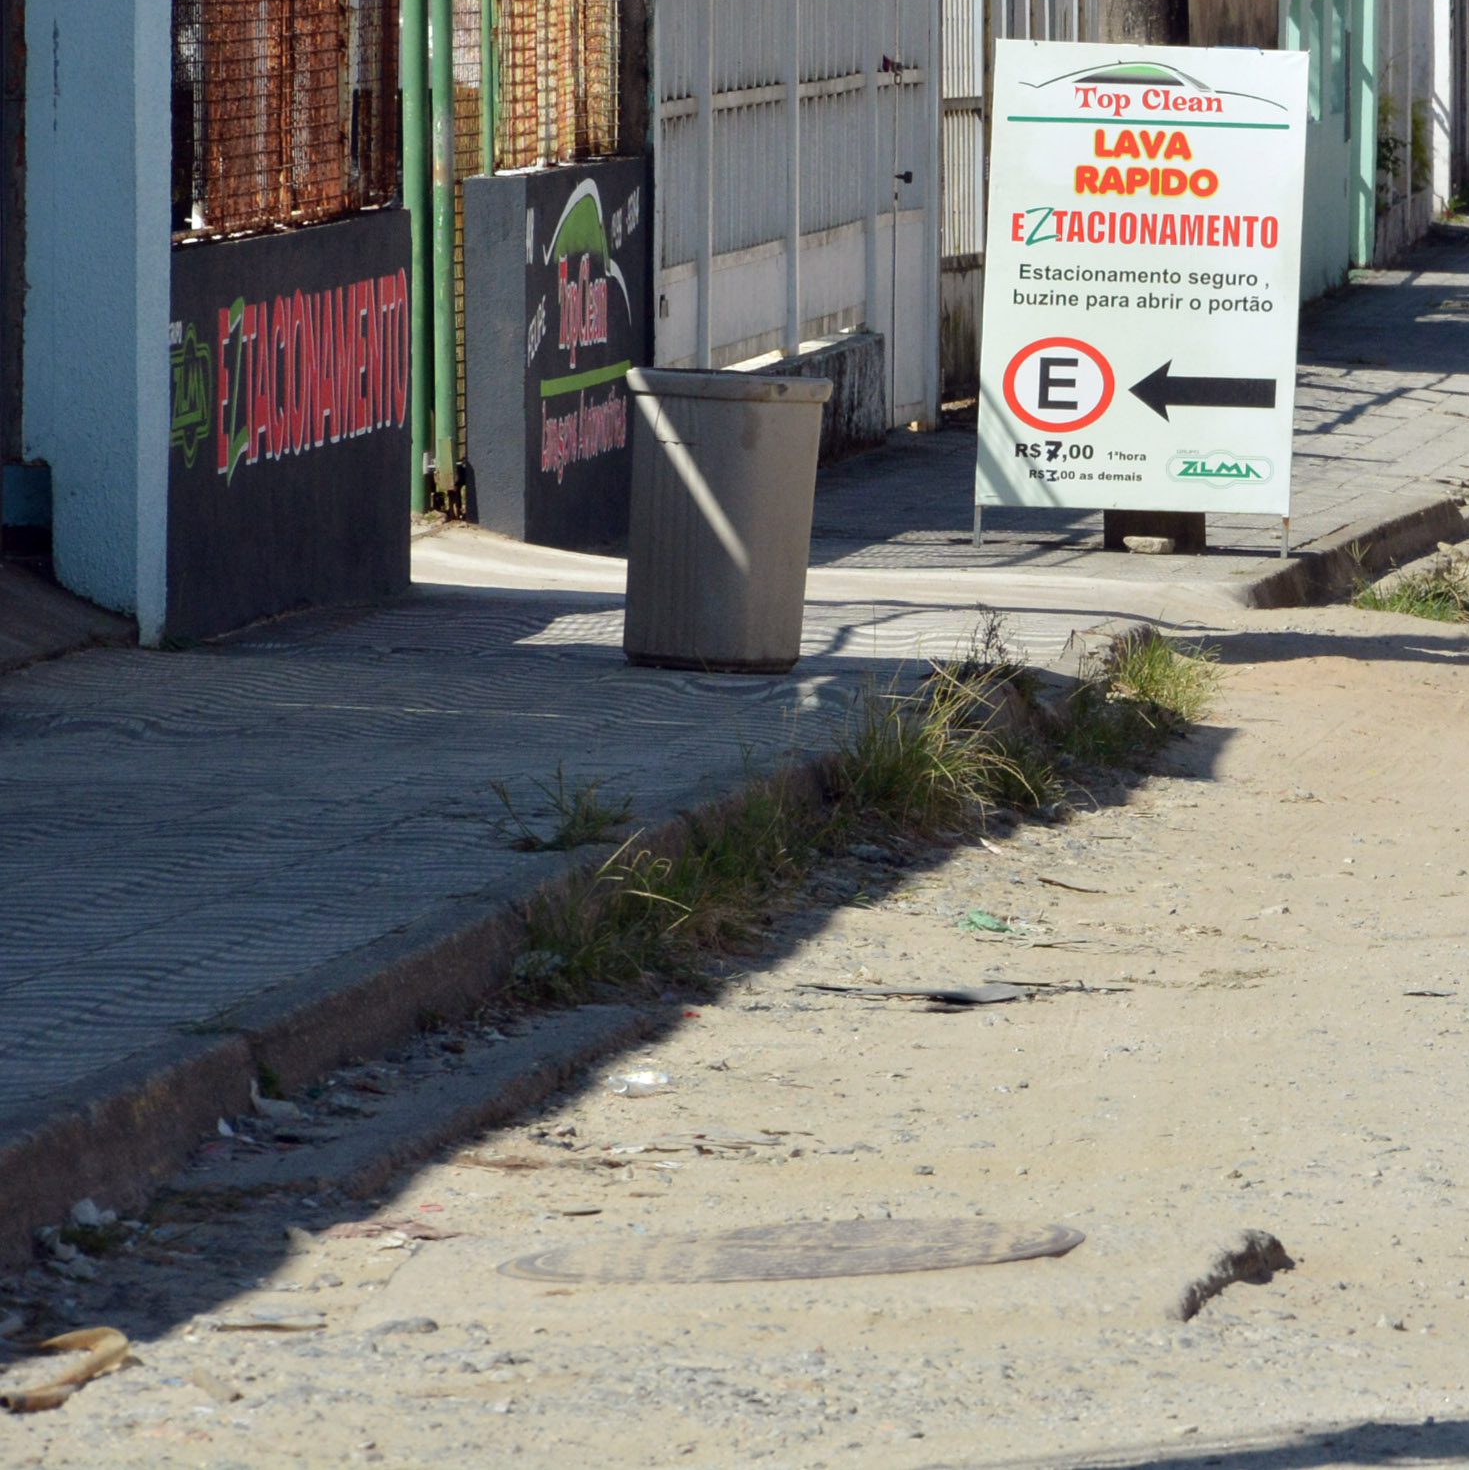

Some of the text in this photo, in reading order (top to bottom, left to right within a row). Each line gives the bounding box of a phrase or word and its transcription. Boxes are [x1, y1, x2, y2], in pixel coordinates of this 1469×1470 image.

[1074, 86, 1223, 117] Top Clean
[1094, 129, 1192, 161] LAVA
[1074, 165, 1219, 198] RAPIDO
[1011, 207, 1279, 249] EZTACIONAMENTO
[1018, 263, 1181, 284] Estacionamento
[1188, 270, 1258, 290] seguro
[1013, 288, 1274, 315] buzine para abrir o portão
[217, 267, 409, 487] EZTACIONAMENTO
[1038, 357, 1079, 410] E
[1079, 472, 1094, 480] as
[1098, 472, 1143, 481] demais
[1177, 461, 1262, 478] ZILMA
